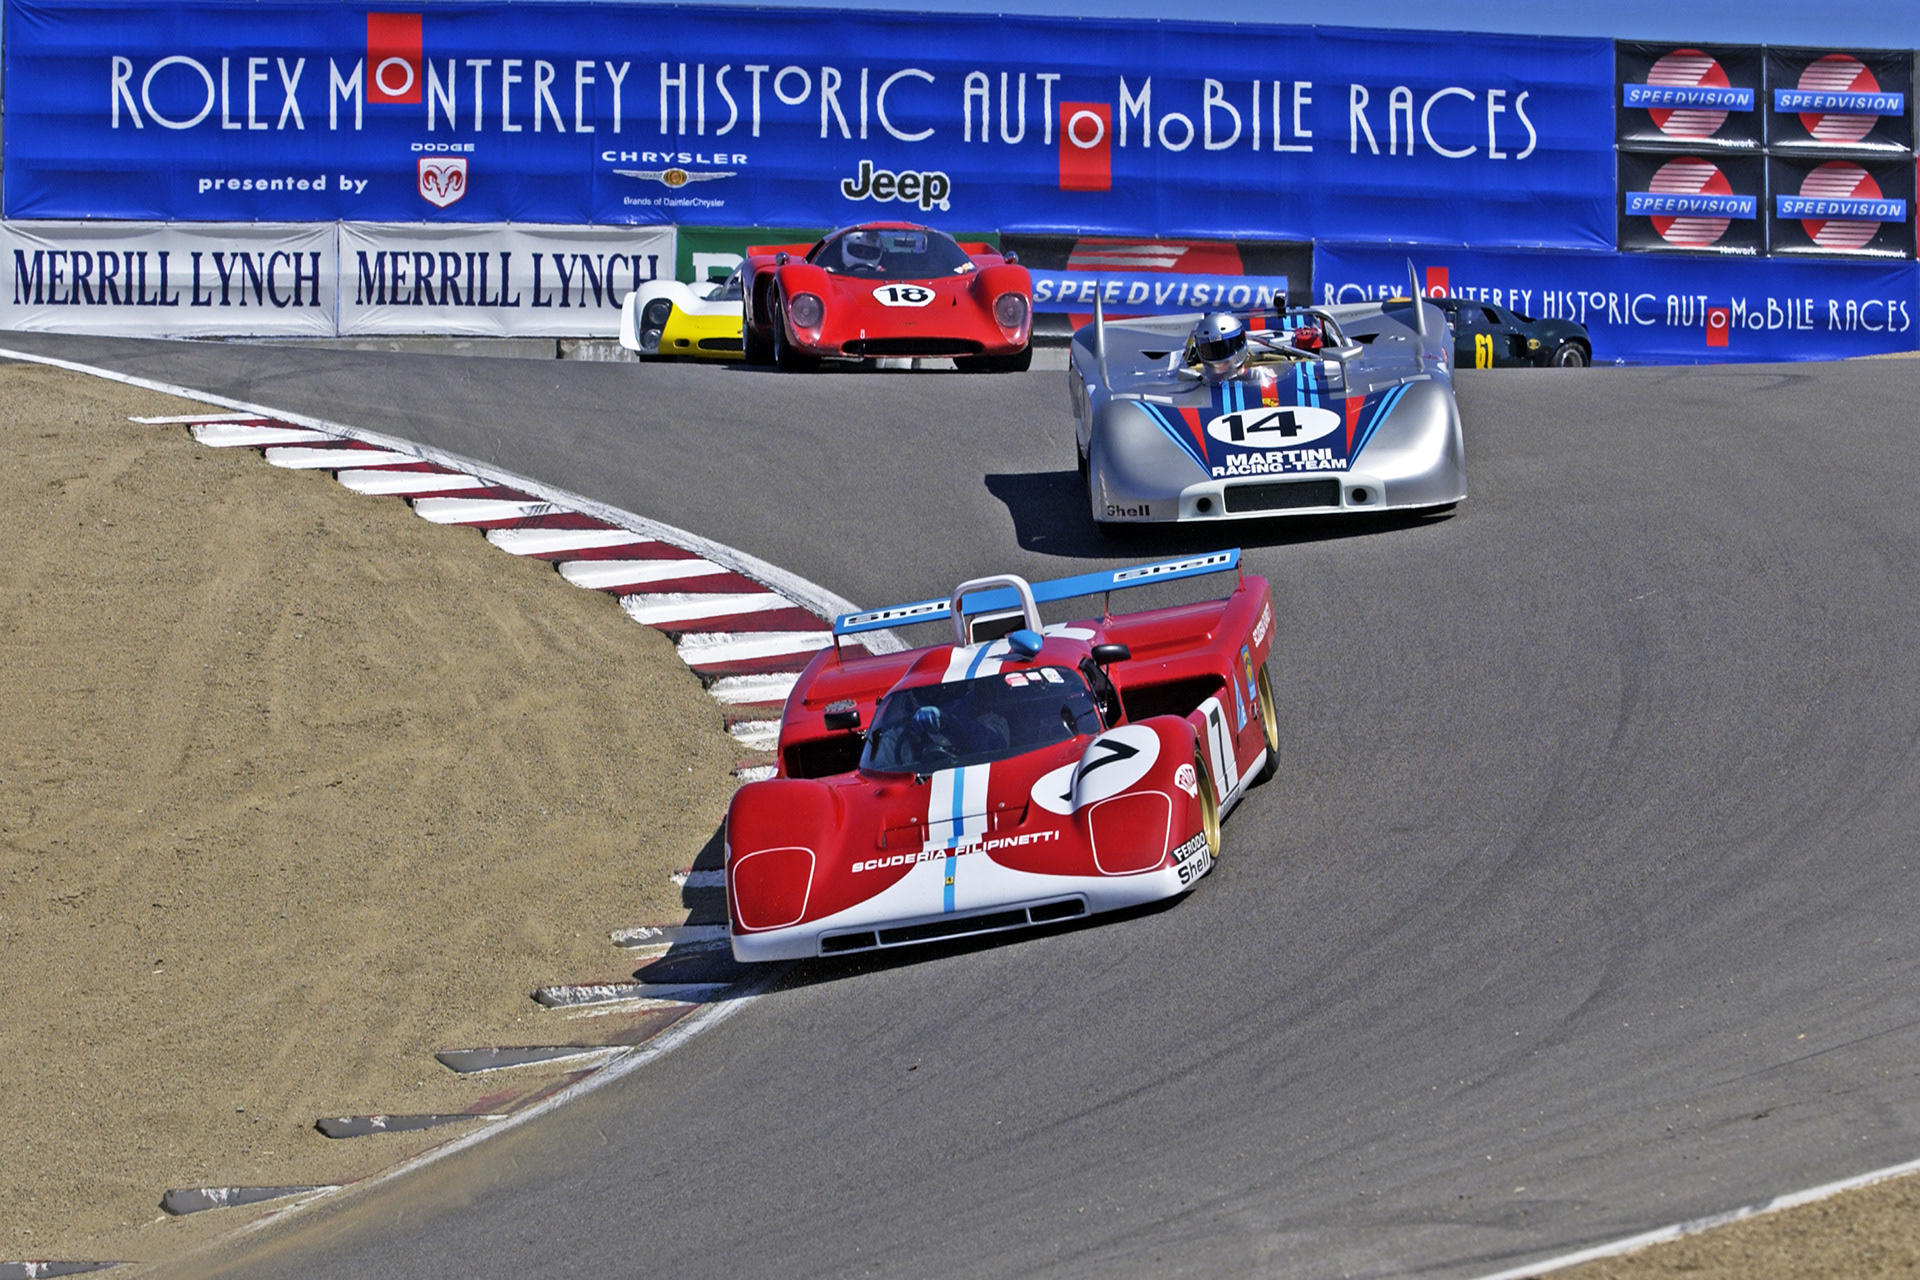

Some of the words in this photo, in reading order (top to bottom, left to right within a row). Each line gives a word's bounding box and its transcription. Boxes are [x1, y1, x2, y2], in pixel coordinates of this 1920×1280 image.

[111, 55, 306, 131] ROLEX
[329, 57, 632, 134] MONTEREY
[660, 61, 936, 142] HISTORIC
[964, 70, 1312, 153] AUTOMOBILE
[1350, 82, 1537, 160] RACES
[1629, 90, 1749, 106] SPEEDVISION
[1780, 94, 1900, 111] SPEEDVISION
[411, 143, 475, 152] DODGE
[602, 151, 748, 165] CHRYSLER
[198, 174, 327, 193] presented
[340, 174, 369, 194] by
[841, 160, 950, 211] Jeep
[623, 197, 652, 206] Brands
[653, 197, 663, 206] of
[664, 197, 725, 208] DaimlerChrysler
[1631, 197, 1752, 214] SPEEDVISION
[1782, 201, 1902, 217] SPEEDVISION
[13, 249, 180, 307] MERRILL
[191, 250, 321, 308] LYNCH
[355, 250, 521, 308] MERRILL
[531, 251, 659, 309] LYNCH
[888, 287, 929, 303] 18
[1033, 279, 1276, 308] SPEEDVISION
[1544, 290, 1656, 326] HISTORIC
[1667, 294, 1814, 330] AUTOMOBILE
[1828, 299, 1911, 333] RACES
[1222, 410, 1303, 442] 14
[1211, 458, 1347, 477] RACING-TEAM
[1226, 448, 1333, 467] MARTINI
[1107, 505, 1150, 517] Shell
[1210, 706, 1230, 793] 7
[1058, 738, 1141, 792] 7
[851, 849, 947, 873] SCUDERIA
[954, 830, 1060, 858] FILIPINETTI
[1174, 831, 1206, 861] FERODO
[1178, 847, 1209, 886] Shell
